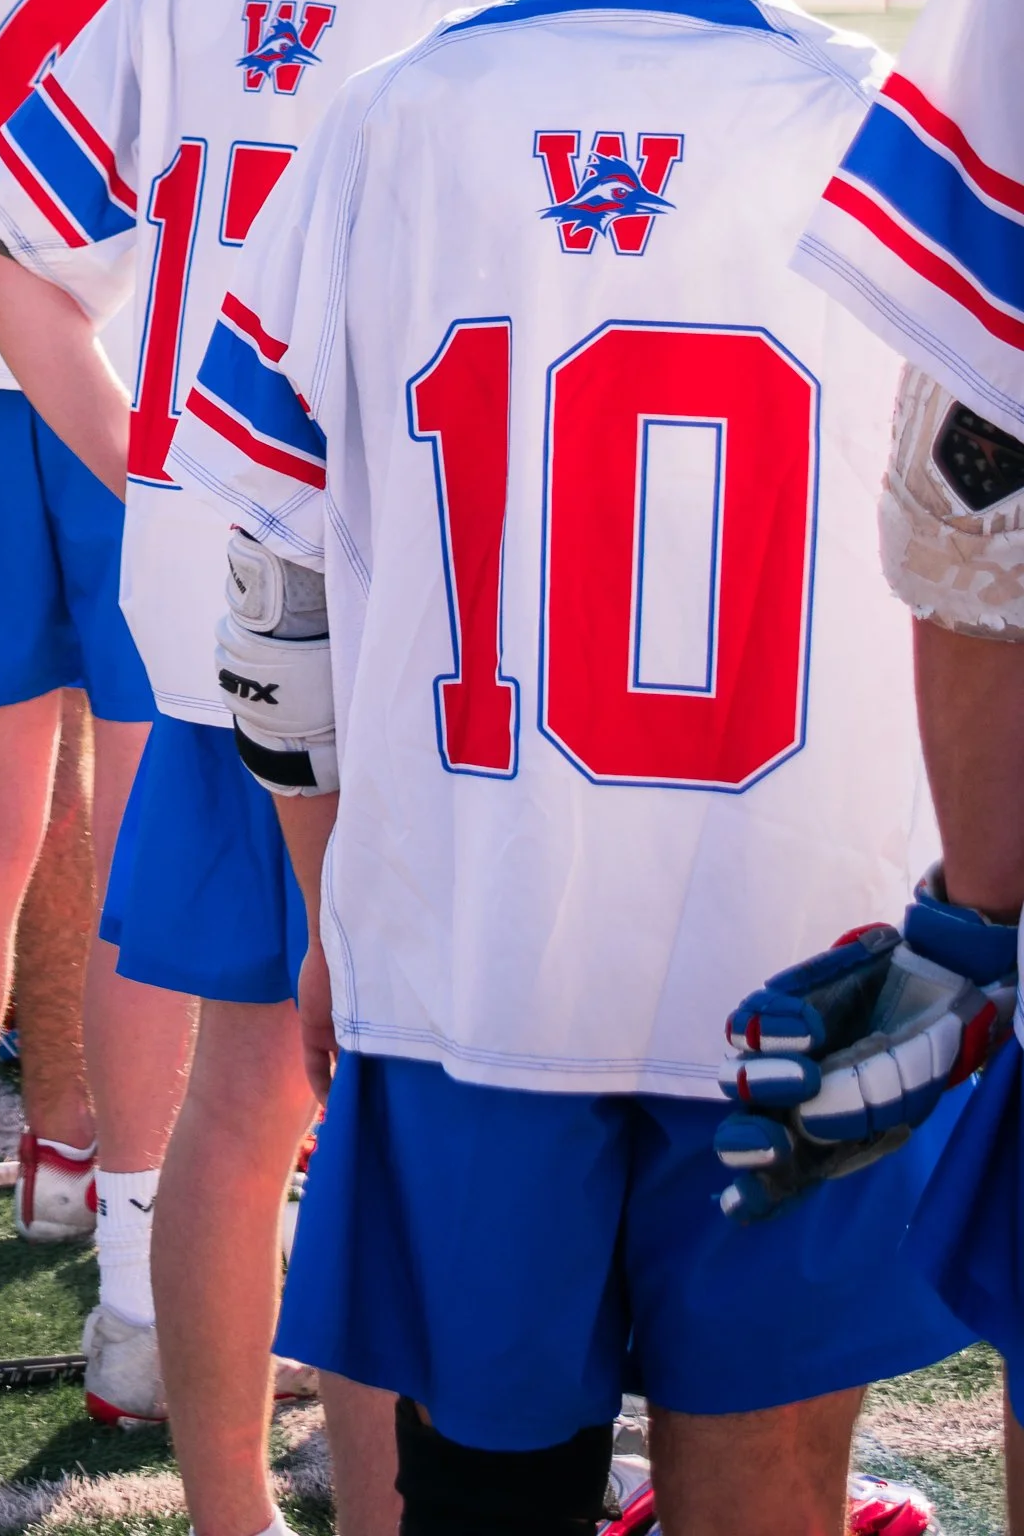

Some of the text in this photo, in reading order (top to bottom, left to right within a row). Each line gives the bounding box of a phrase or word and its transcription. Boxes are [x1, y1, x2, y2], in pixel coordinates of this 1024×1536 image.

[236, 0, 336, 95] W
[533, 130, 685, 256] W
[406, 316, 821, 794] 10
[218, 668, 280, 705] STX
